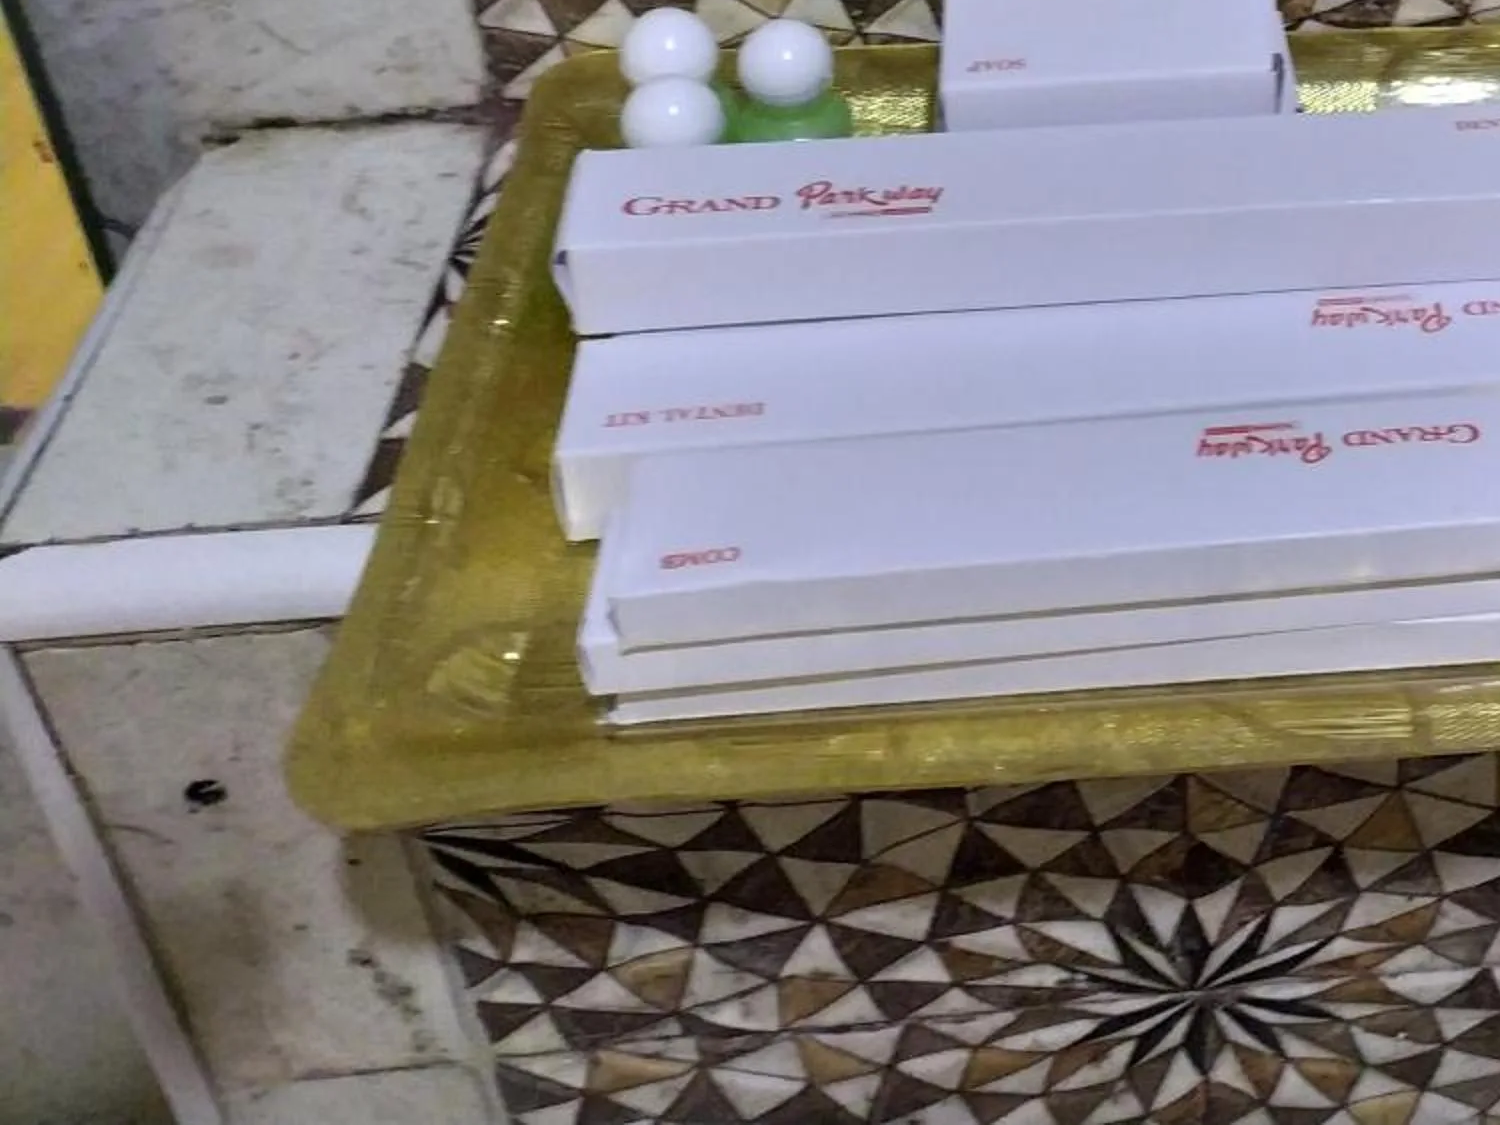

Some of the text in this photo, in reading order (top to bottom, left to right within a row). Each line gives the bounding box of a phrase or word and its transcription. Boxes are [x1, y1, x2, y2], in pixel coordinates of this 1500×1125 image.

[621, 180, 944, 217] GRAND Parkway
[1311, 301, 1453, 333] Parkway
[1196, 422, 1481, 464] GRAND Parkway
